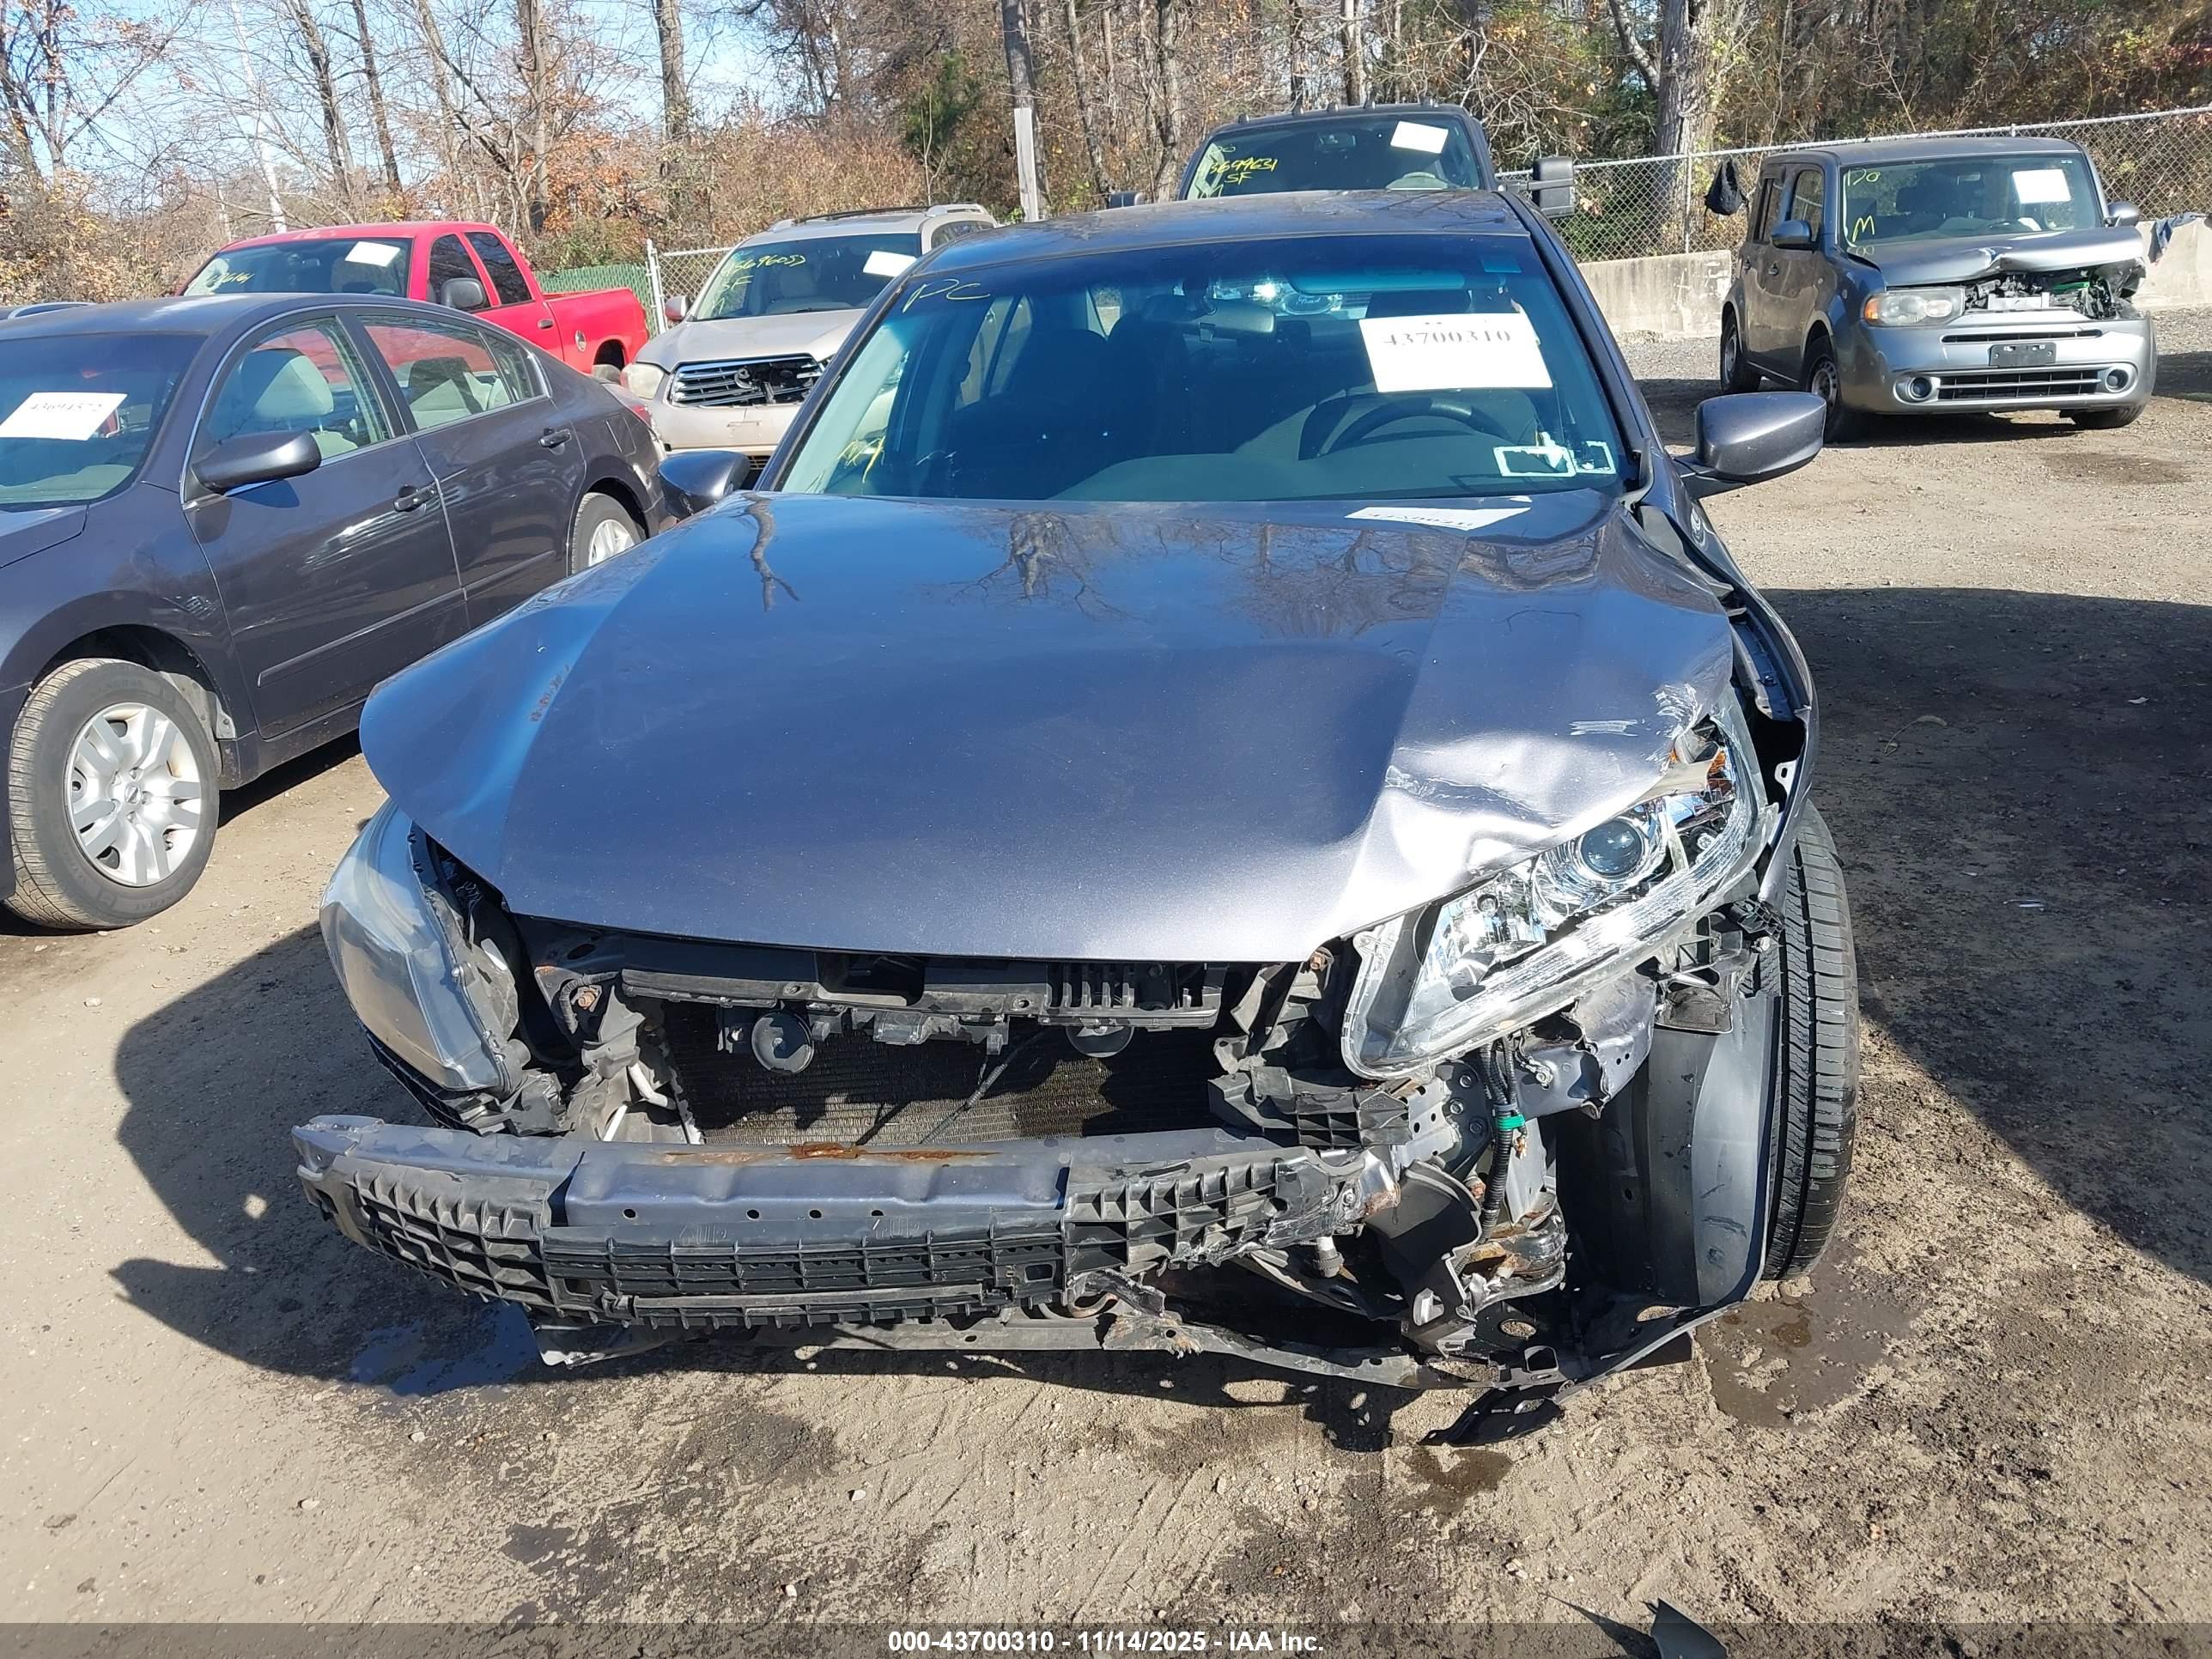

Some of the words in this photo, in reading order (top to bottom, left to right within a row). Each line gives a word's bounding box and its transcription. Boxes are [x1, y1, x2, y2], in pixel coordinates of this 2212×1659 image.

[1224, 172, 1253, 185] SF
[1852, 215, 1876, 243] M
[902, 278, 992, 314] PC
[1382, 329, 1511, 345] 43700310
